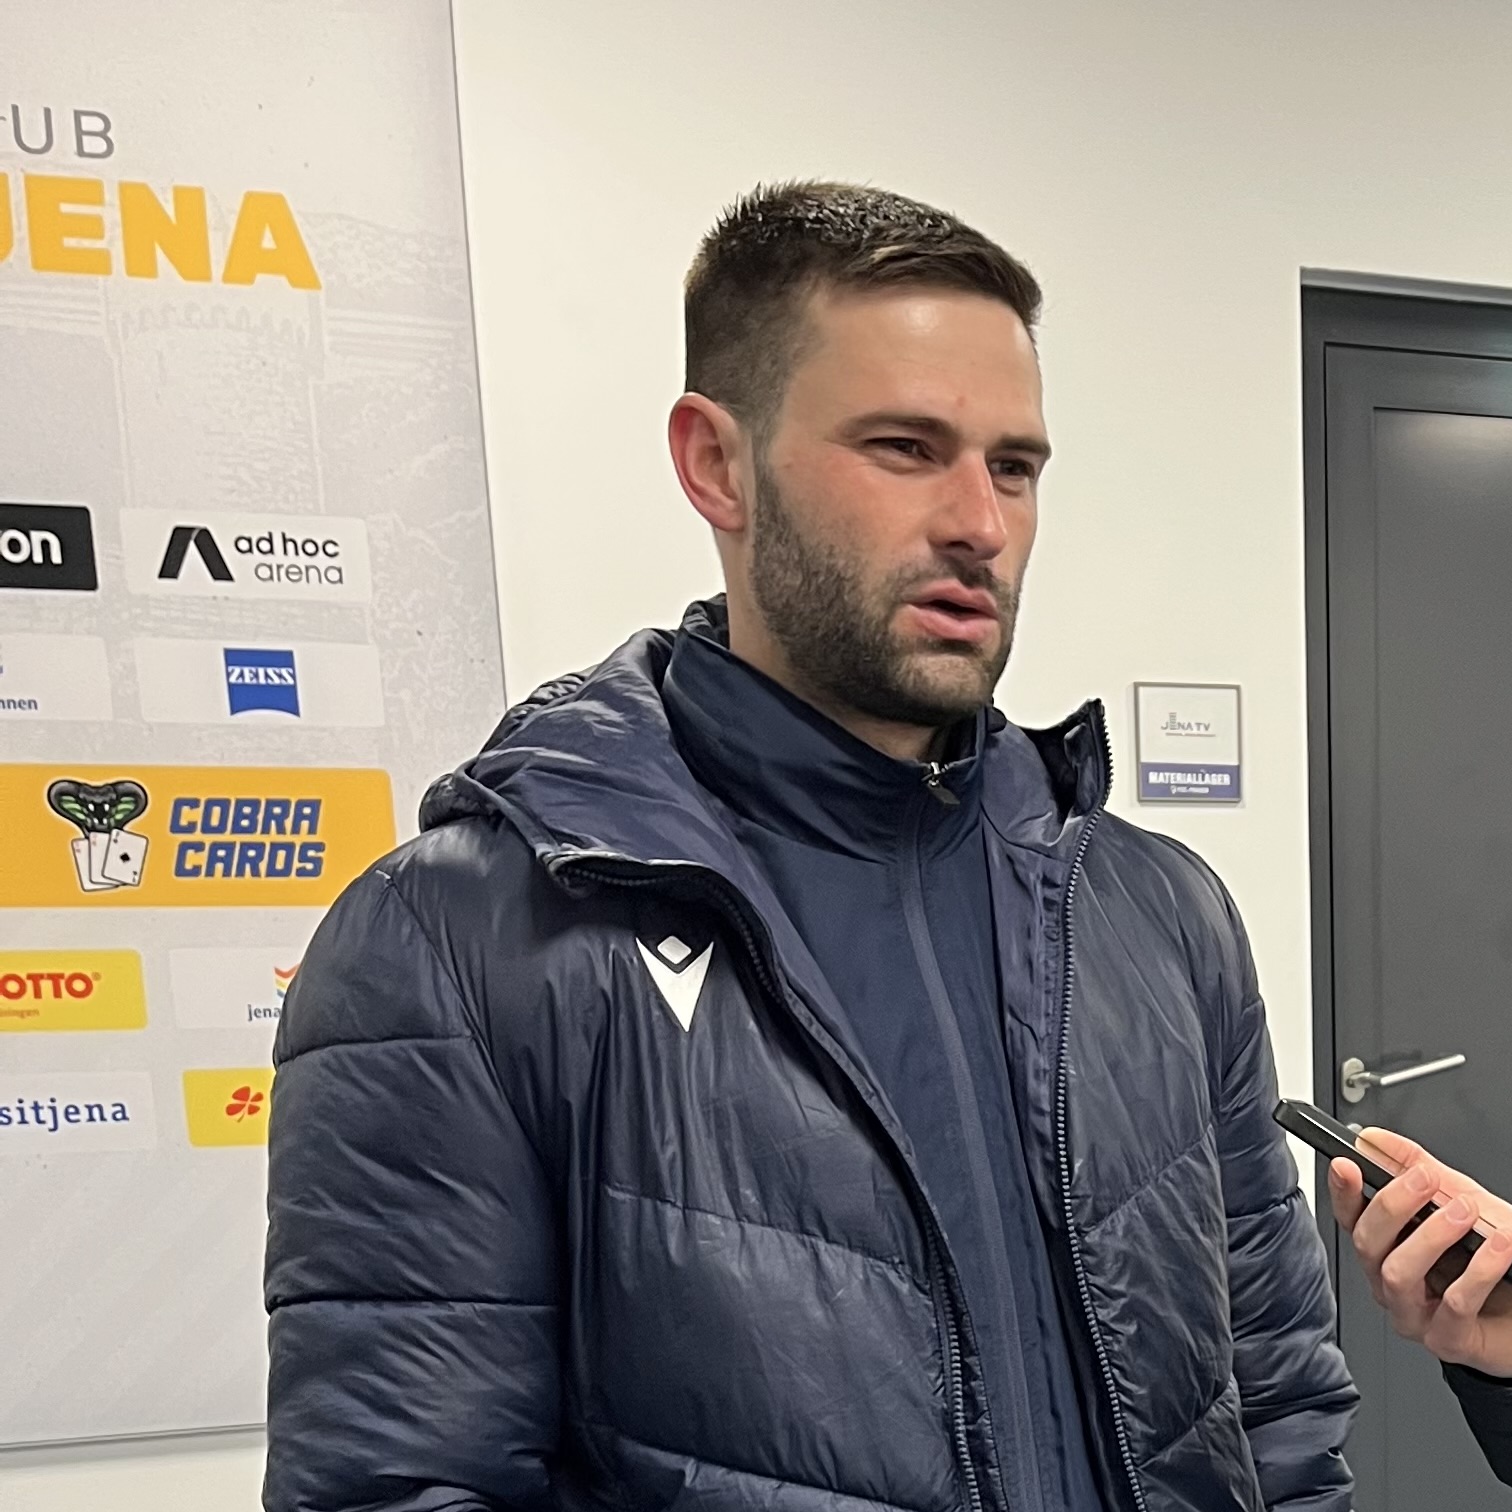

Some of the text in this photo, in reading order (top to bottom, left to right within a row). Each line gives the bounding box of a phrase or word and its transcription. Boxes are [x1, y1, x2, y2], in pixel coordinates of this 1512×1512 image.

[0, 103, 114, 159] UB
[0, 528, 63, 565] on
[234, 532, 340, 558] ad hoc
[254, 562, 345, 586] arena
[227, 666, 296, 686] ZEISS
[169, 797, 322, 835] COBRA
[174, 841, 326, 878] CARDS
[0, 1097, 130, 1132] sitjena
